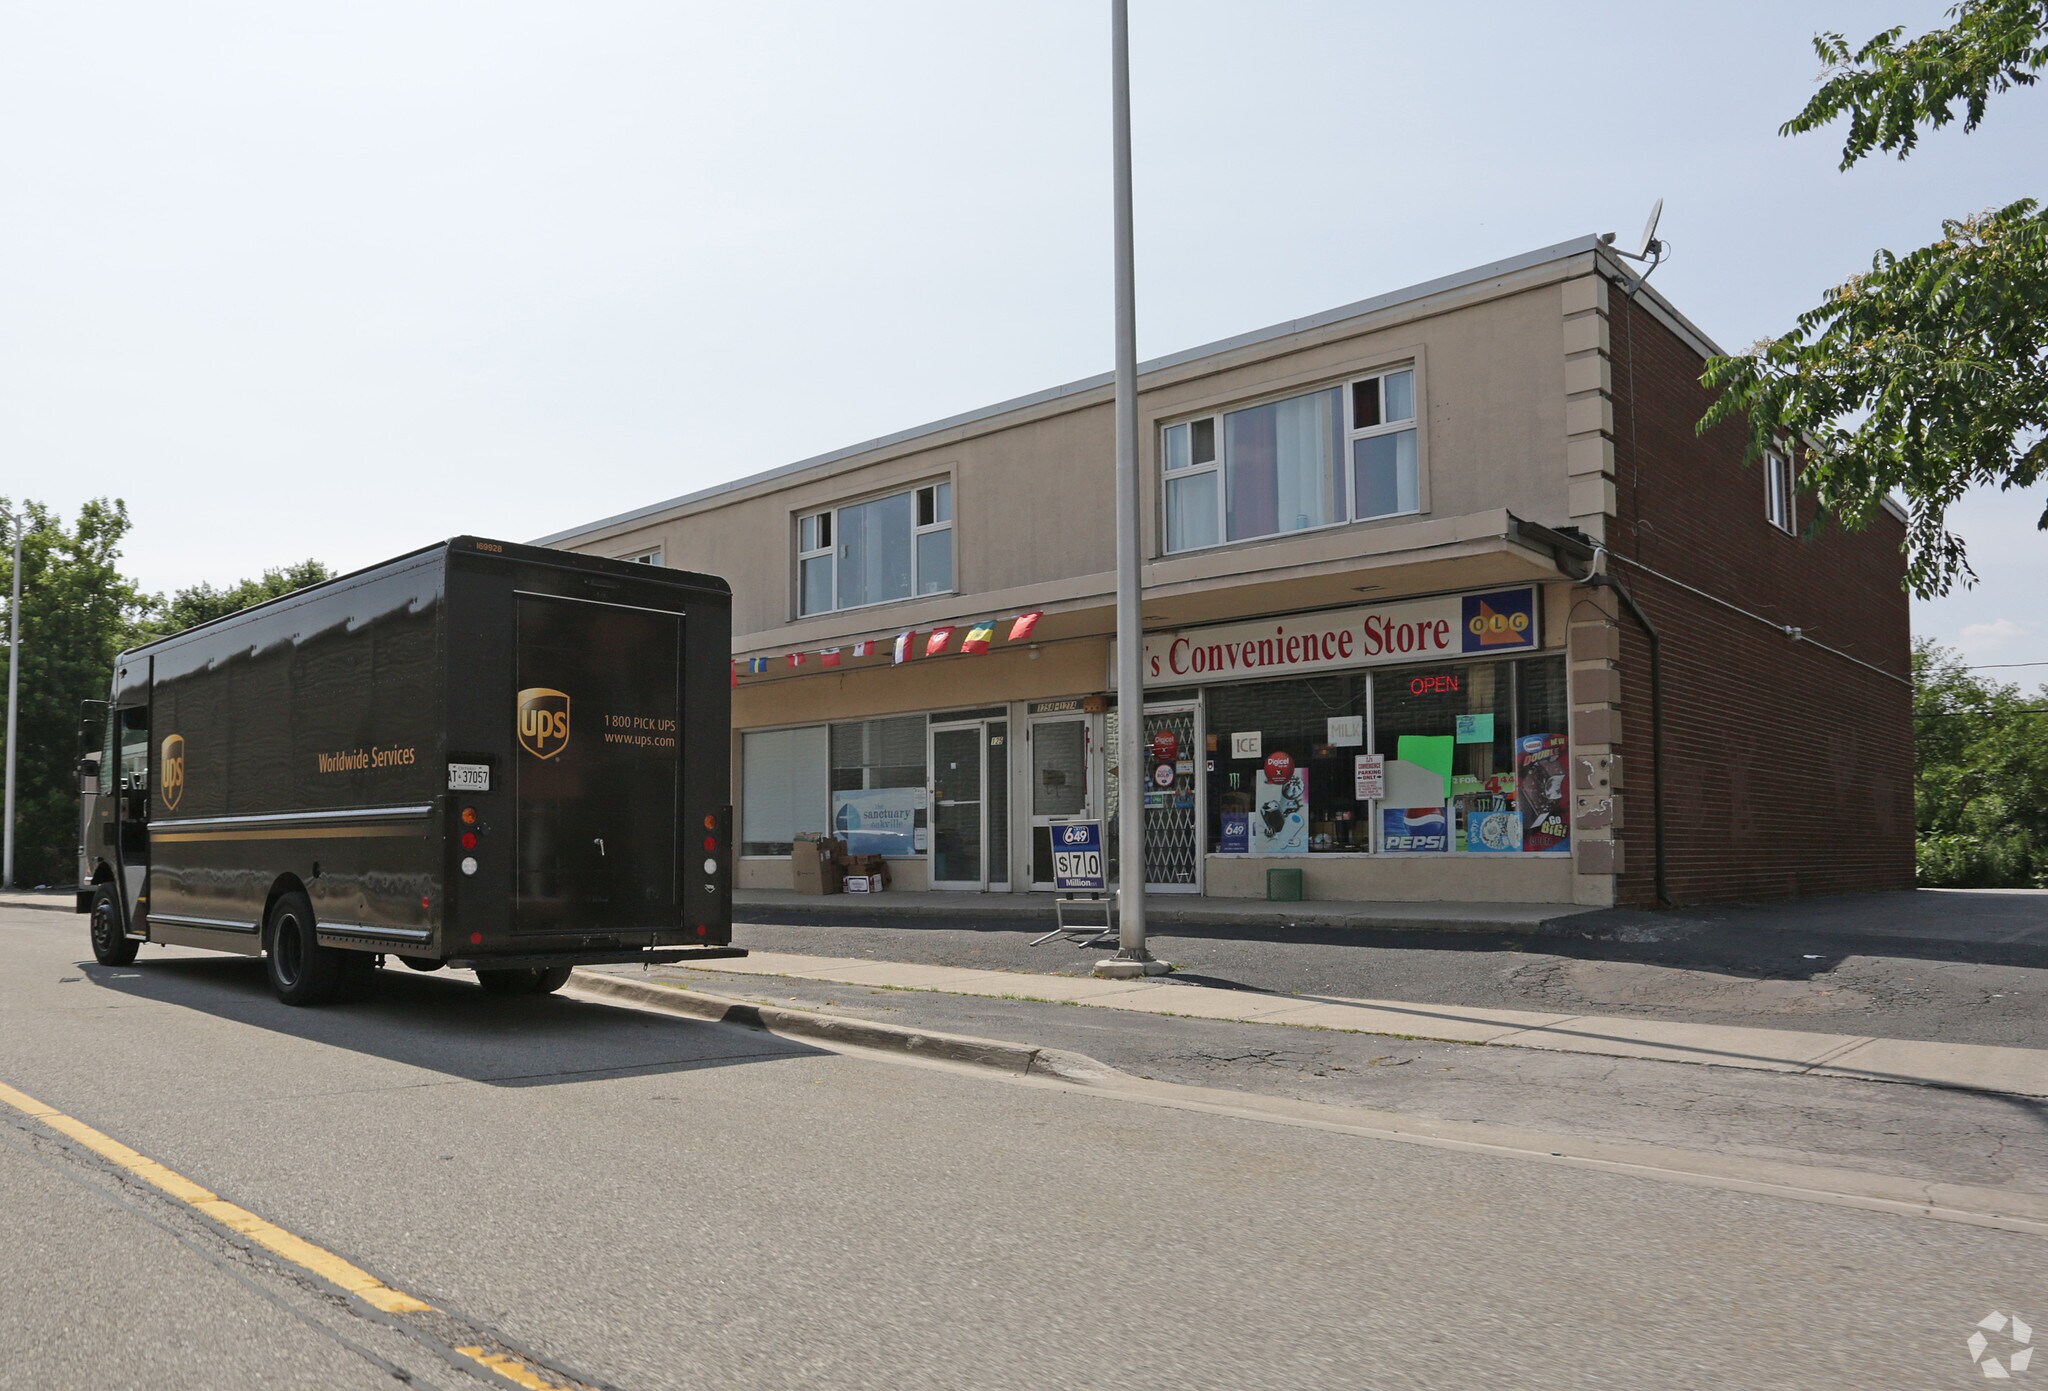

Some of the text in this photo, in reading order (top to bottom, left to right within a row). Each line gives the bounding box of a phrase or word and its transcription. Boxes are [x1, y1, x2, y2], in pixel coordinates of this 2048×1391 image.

[1472, 614, 1525, 633] OLG
[1168, 626, 1354, 676] Convenience
[1363, 615, 1450, 656] Store
[1410, 675, 1459, 695] OPEN
[520, 709, 567, 749] ups
[604, 714, 676, 732] 1 800 PICK UPS
[1331, 723, 1360, 737] MILK
[604, 733, 675, 748] www.ups.com
[1236, 738, 1258, 753] ICE
[318, 744, 415, 774] Worldwide Services
[1267, 757, 1290, 767] Digicel
[162, 757, 183, 799] ups
[462, 771, 488, 784] 37057
[863, 809, 911, 820] sanctuary
[1386, 836, 1445, 850] PEPSI
[1065, 879, 1091, 887] Million
